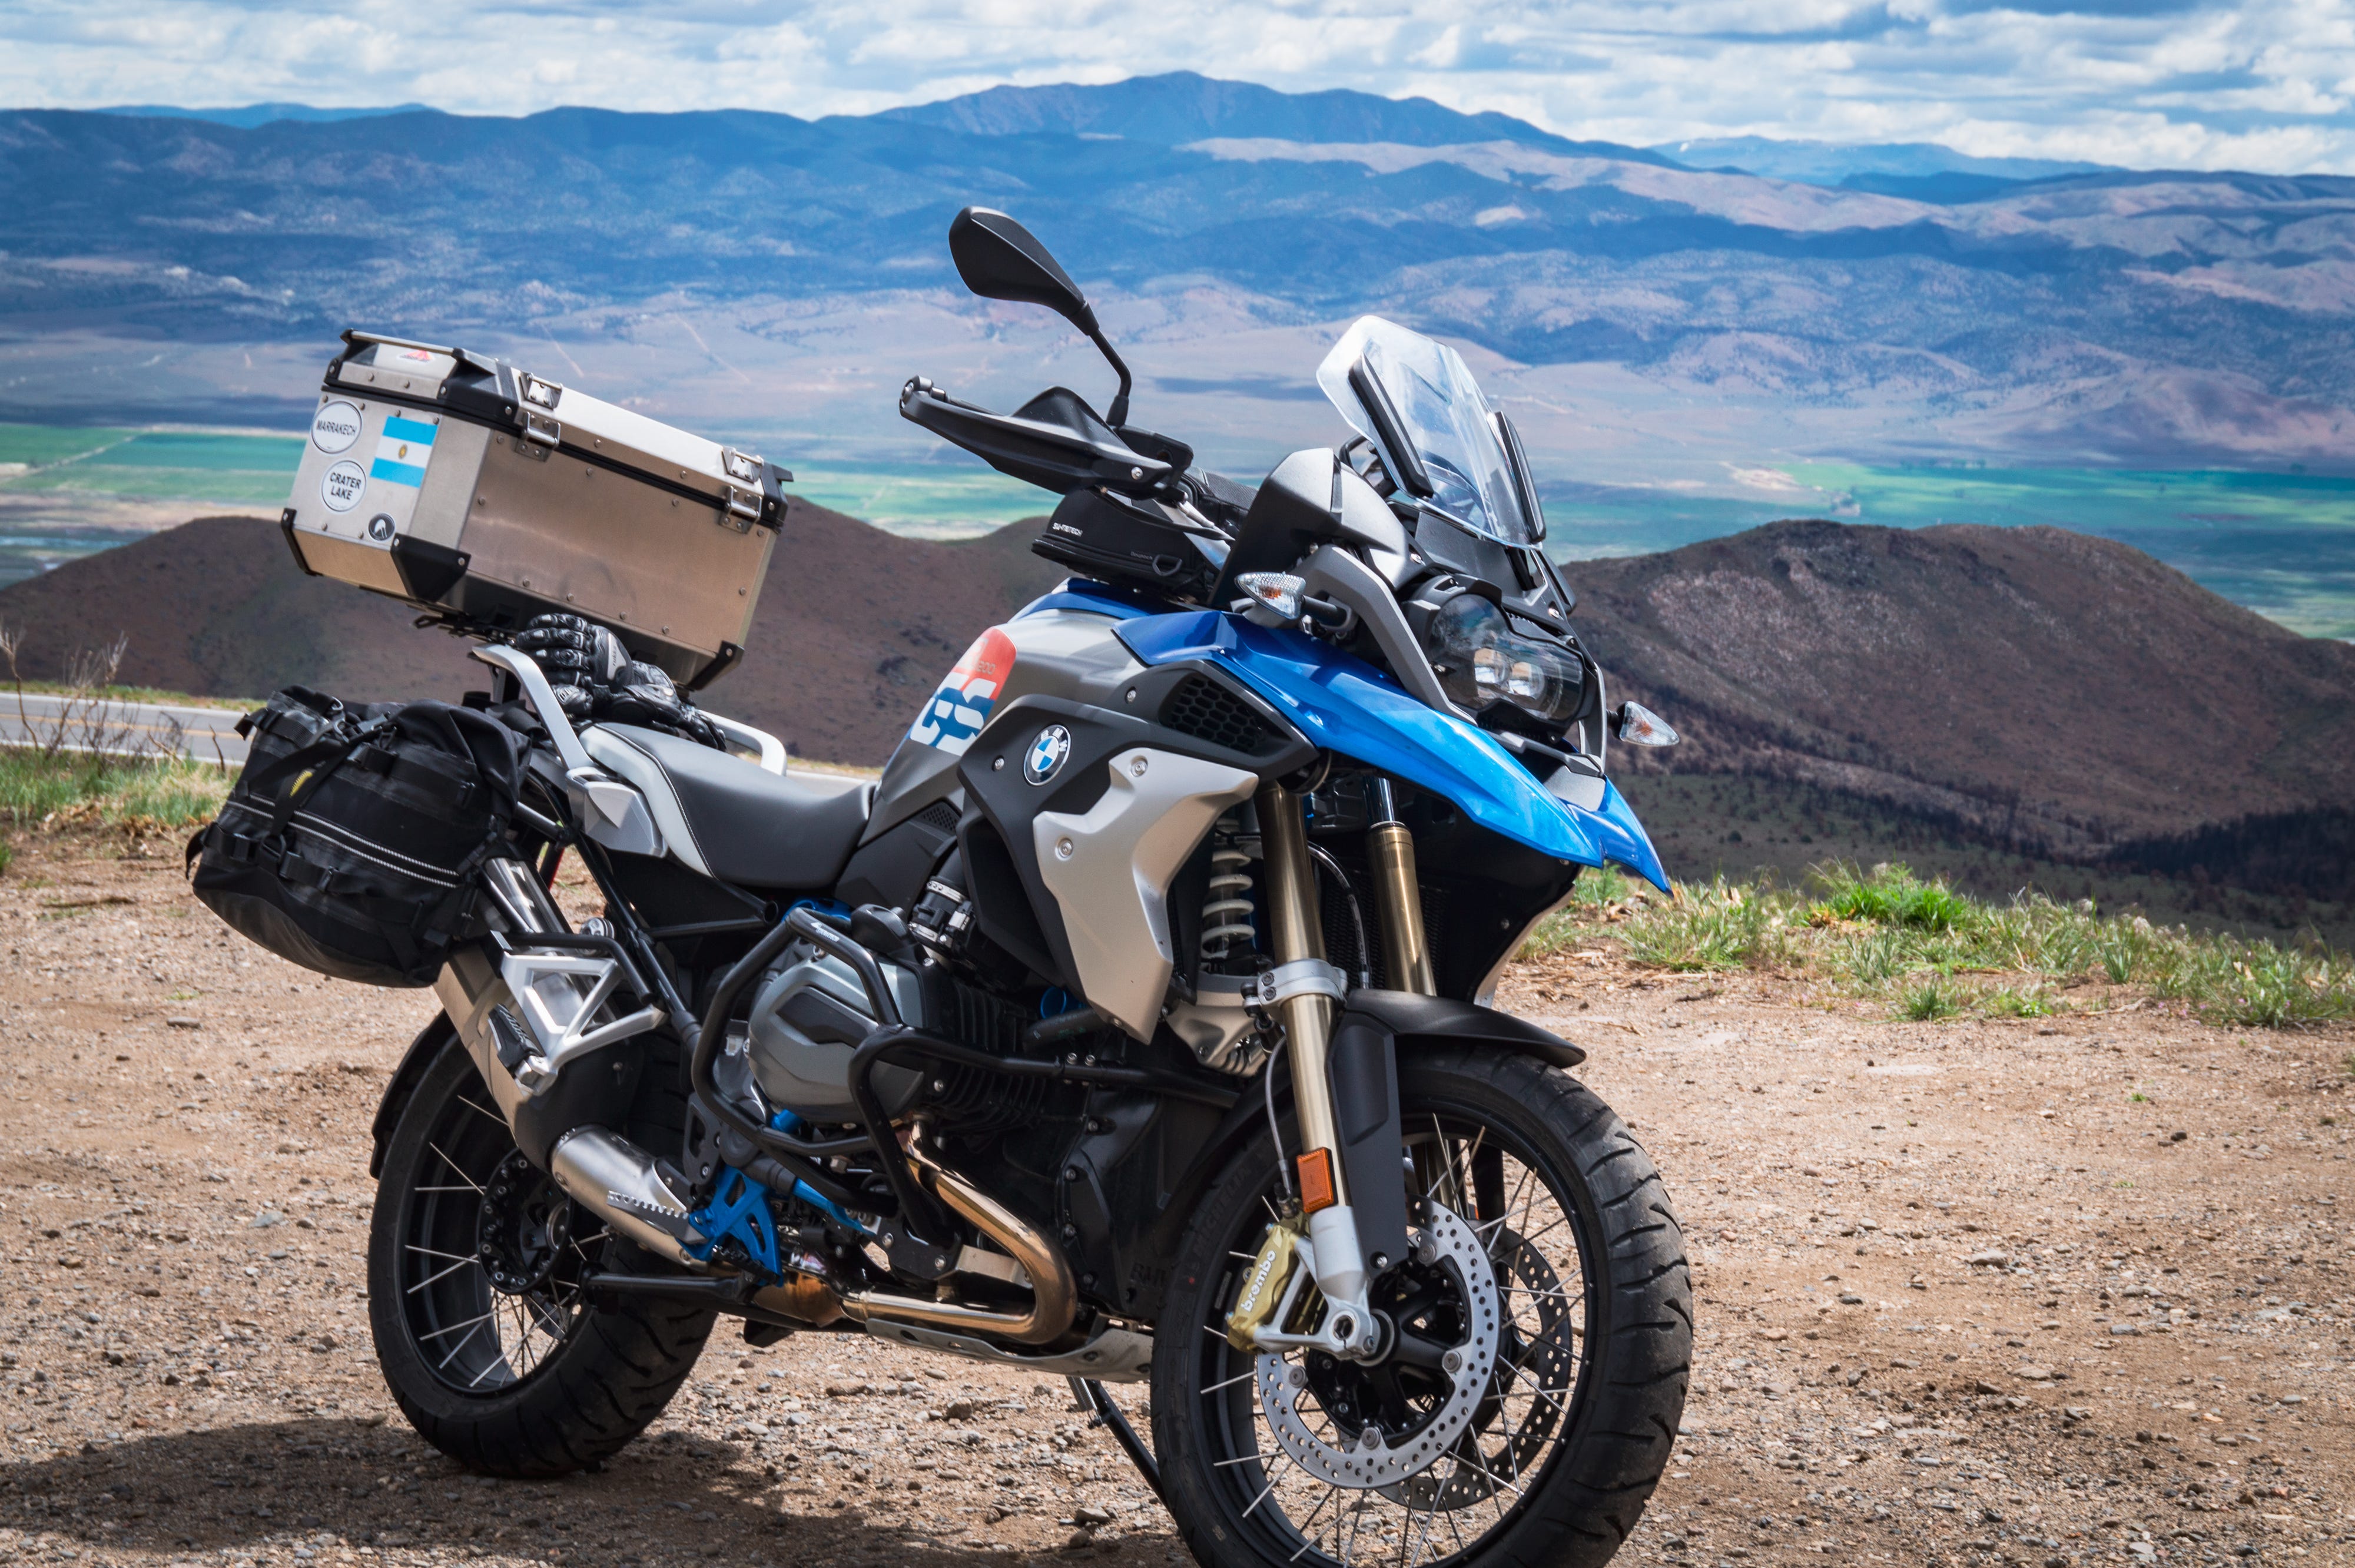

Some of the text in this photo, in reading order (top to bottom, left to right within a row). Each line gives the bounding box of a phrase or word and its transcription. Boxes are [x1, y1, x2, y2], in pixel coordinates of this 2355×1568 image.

[316, 420, 357, 436] MARRAKECH
[330, 472, 361, 489] CRATER
[331, 485, 353, 500] LAKE
[1041, 727, 1067, 752] BMW
[1240, 1250, 1276, 1312] brembo
